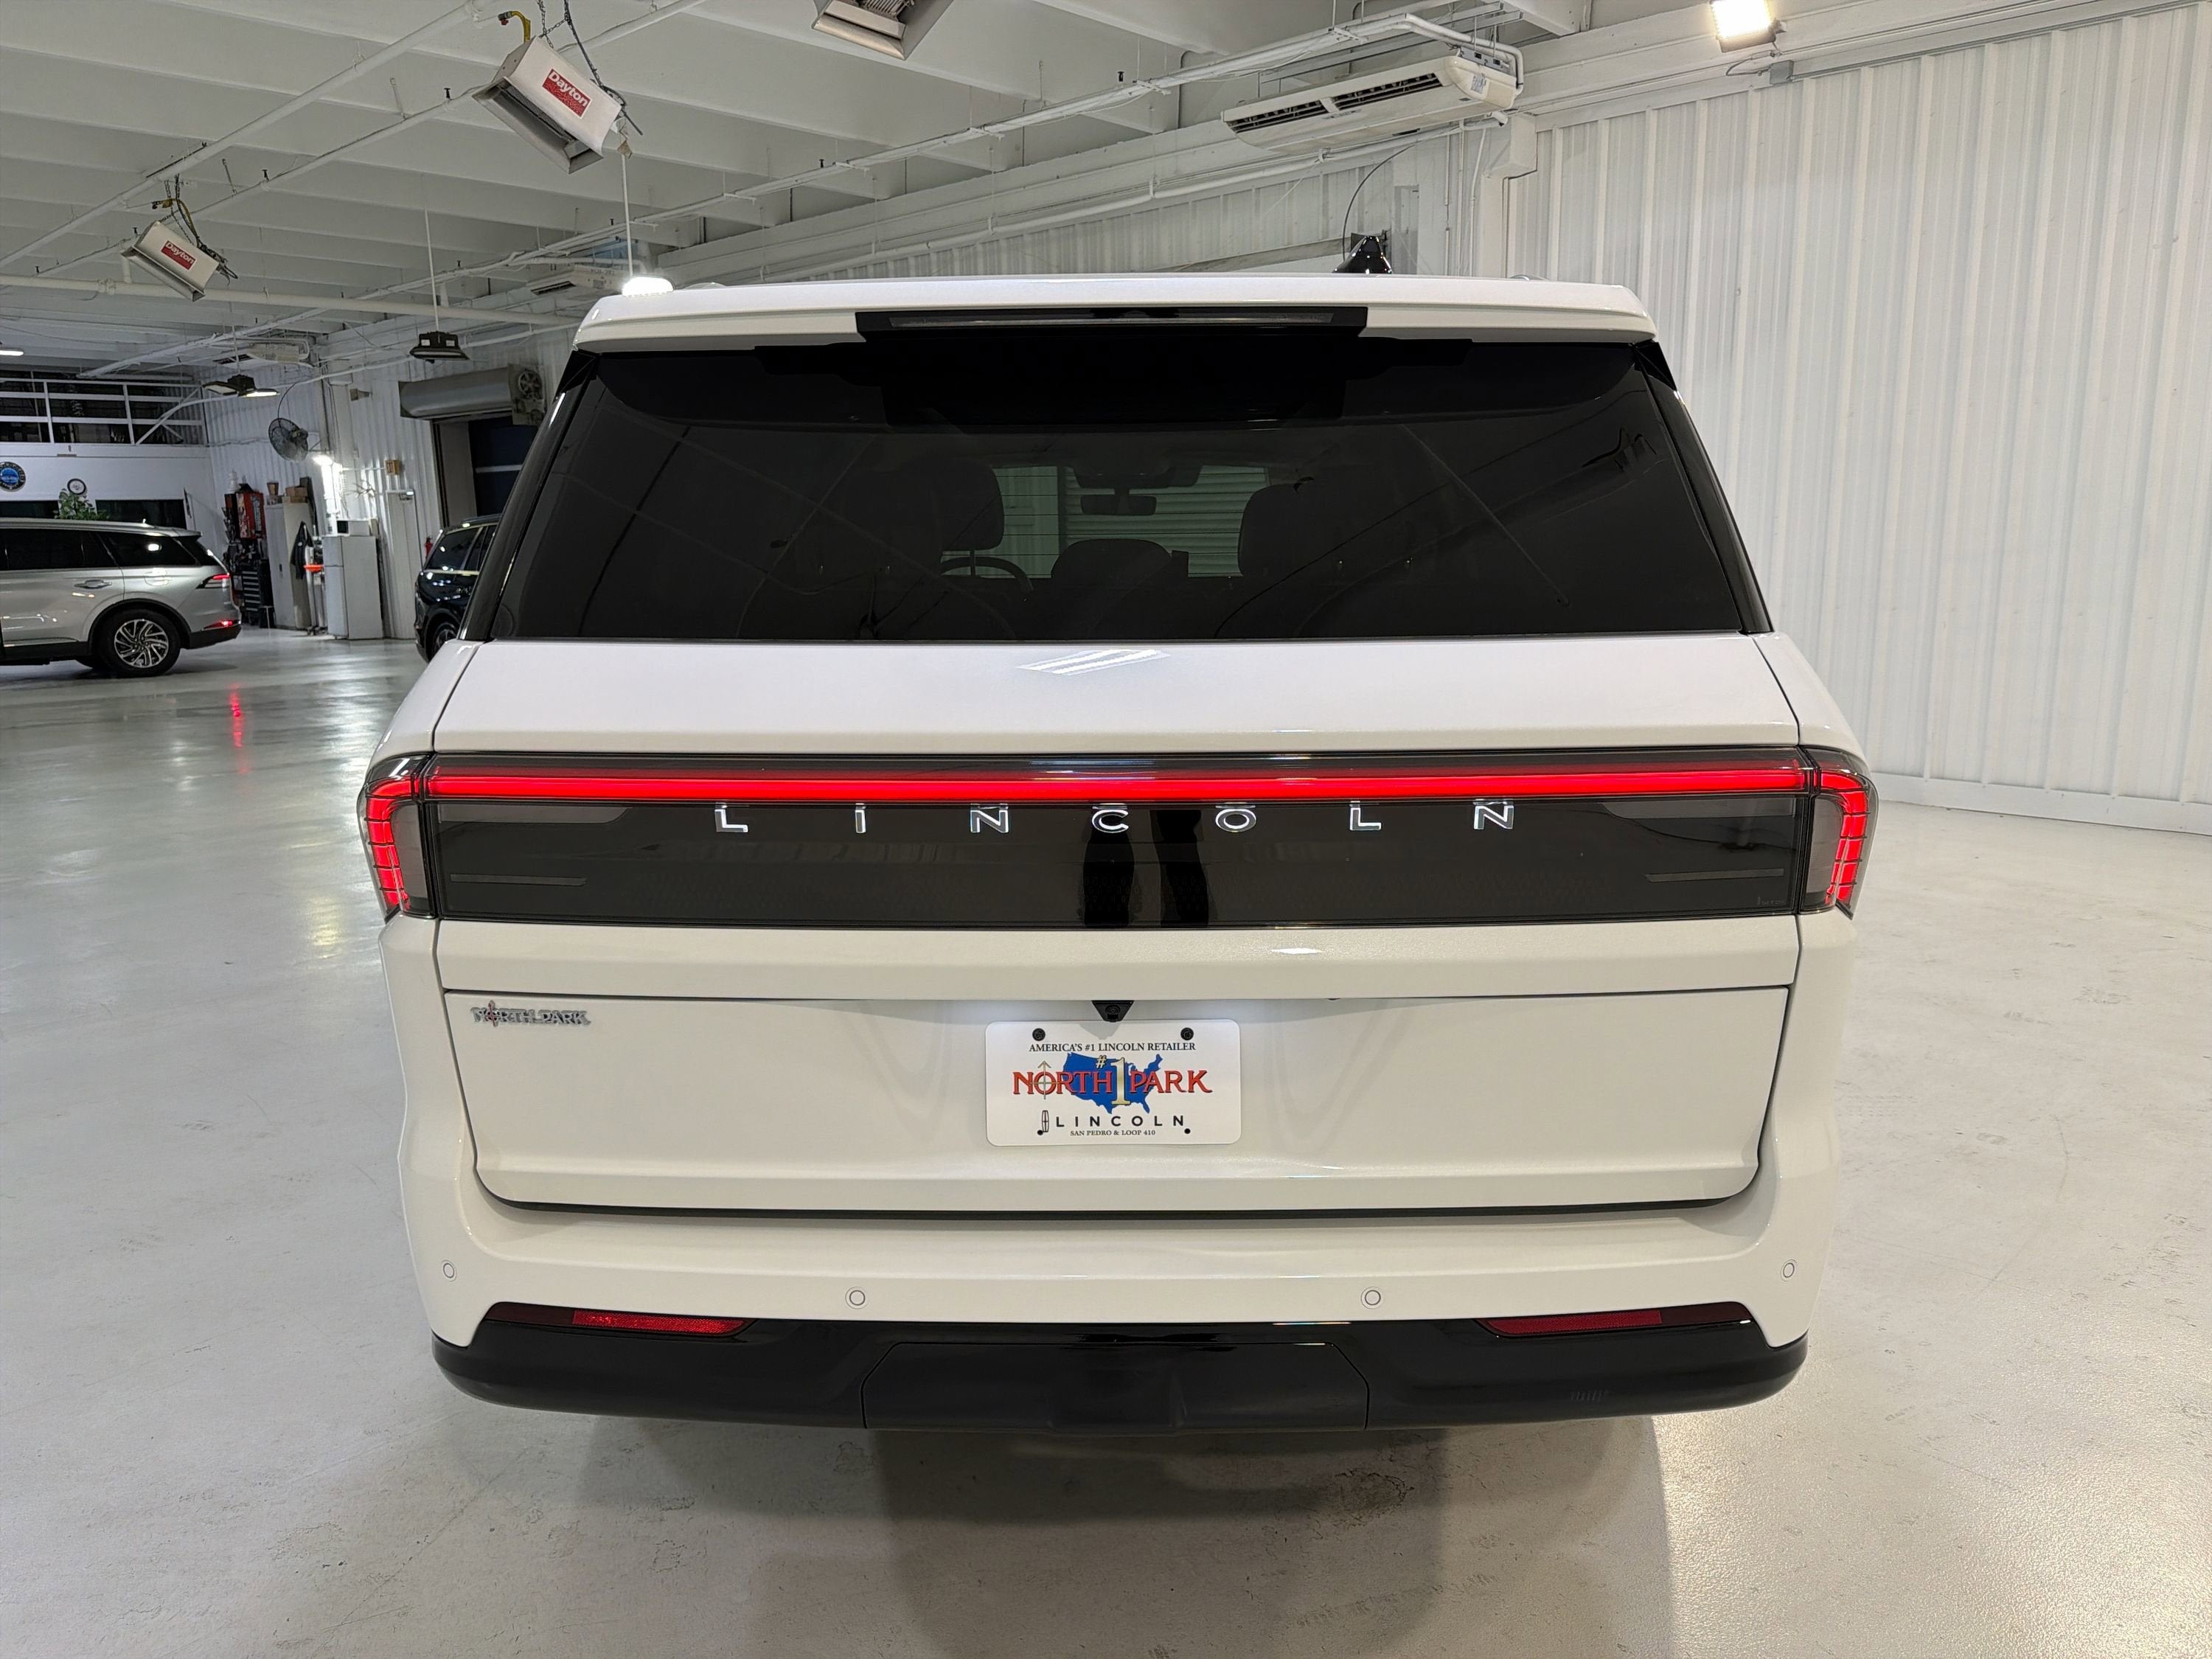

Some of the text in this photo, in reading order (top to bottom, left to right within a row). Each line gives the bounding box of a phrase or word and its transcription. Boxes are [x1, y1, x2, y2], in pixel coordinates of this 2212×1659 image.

[548, 71, 588, 107] Dayton
[165, 242, 195, 264] Dayton
[714, 805, 1514, 834] LINCOLN
[470, 1007, 591, 1025] NORTH PARK
[1029, 1042, 1197, 1052] AMERICA'S #1 LINCOLN RETAILER
[1012, 1070, 1214, 1095] NORTH PARK
[1056, 1115, 1184, 1127] LINCOLN
